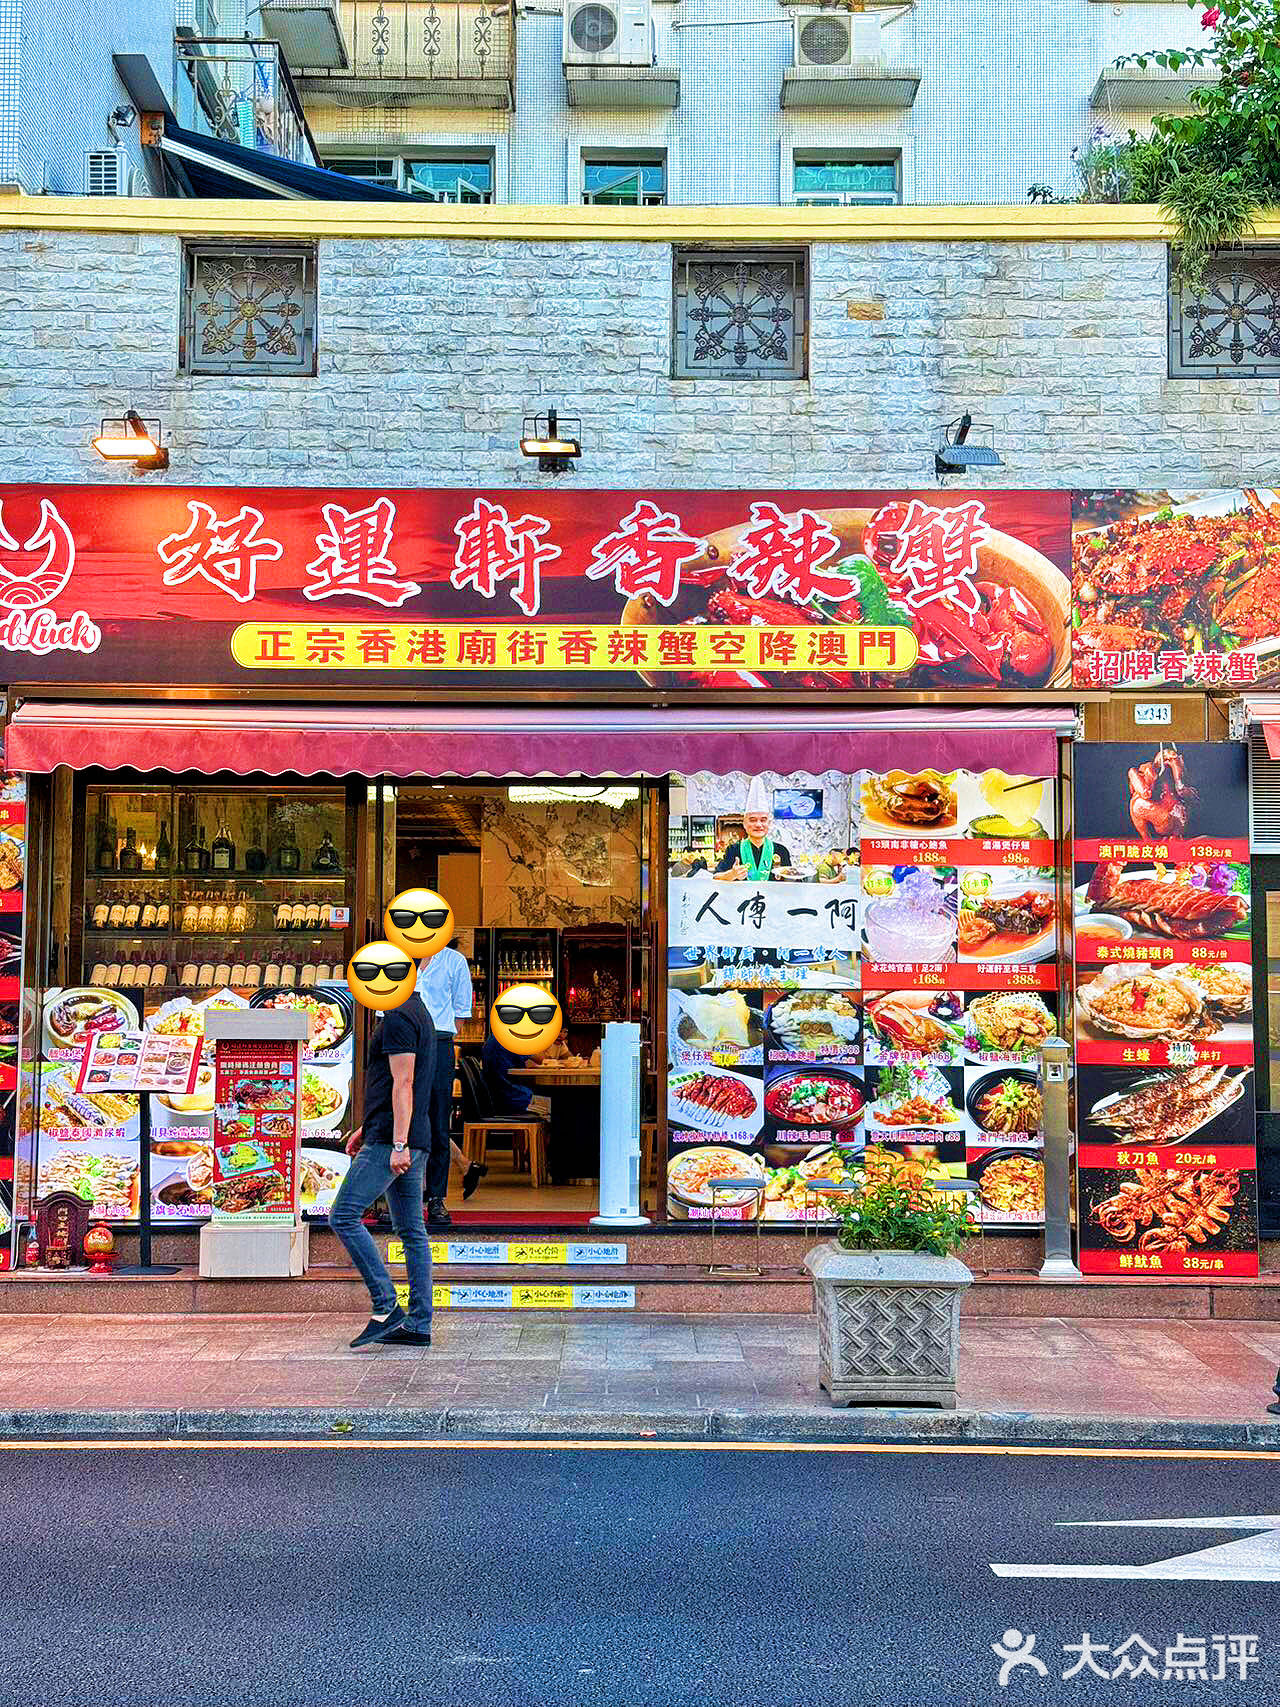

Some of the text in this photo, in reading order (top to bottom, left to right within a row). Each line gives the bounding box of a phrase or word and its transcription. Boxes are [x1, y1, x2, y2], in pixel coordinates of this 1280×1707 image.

[157, 496, 993, 616] 好運軒香辣蟹
[254, 629, 898, 667] 正宗香港廟街香辣蟹空降澳門
[1090, 650, 1258, 682] 招牌香辣蟹
[1149, 707, 1168, 721] 343
[1116, 1151, 1159, 1165] 秋刀魚
[1175, 1152, 1217, 1165] 20元/串
[1119, 1254, 1163, 1269] 鮮魷魚
[1183, 1257, 1225, 1270] 38元/串
